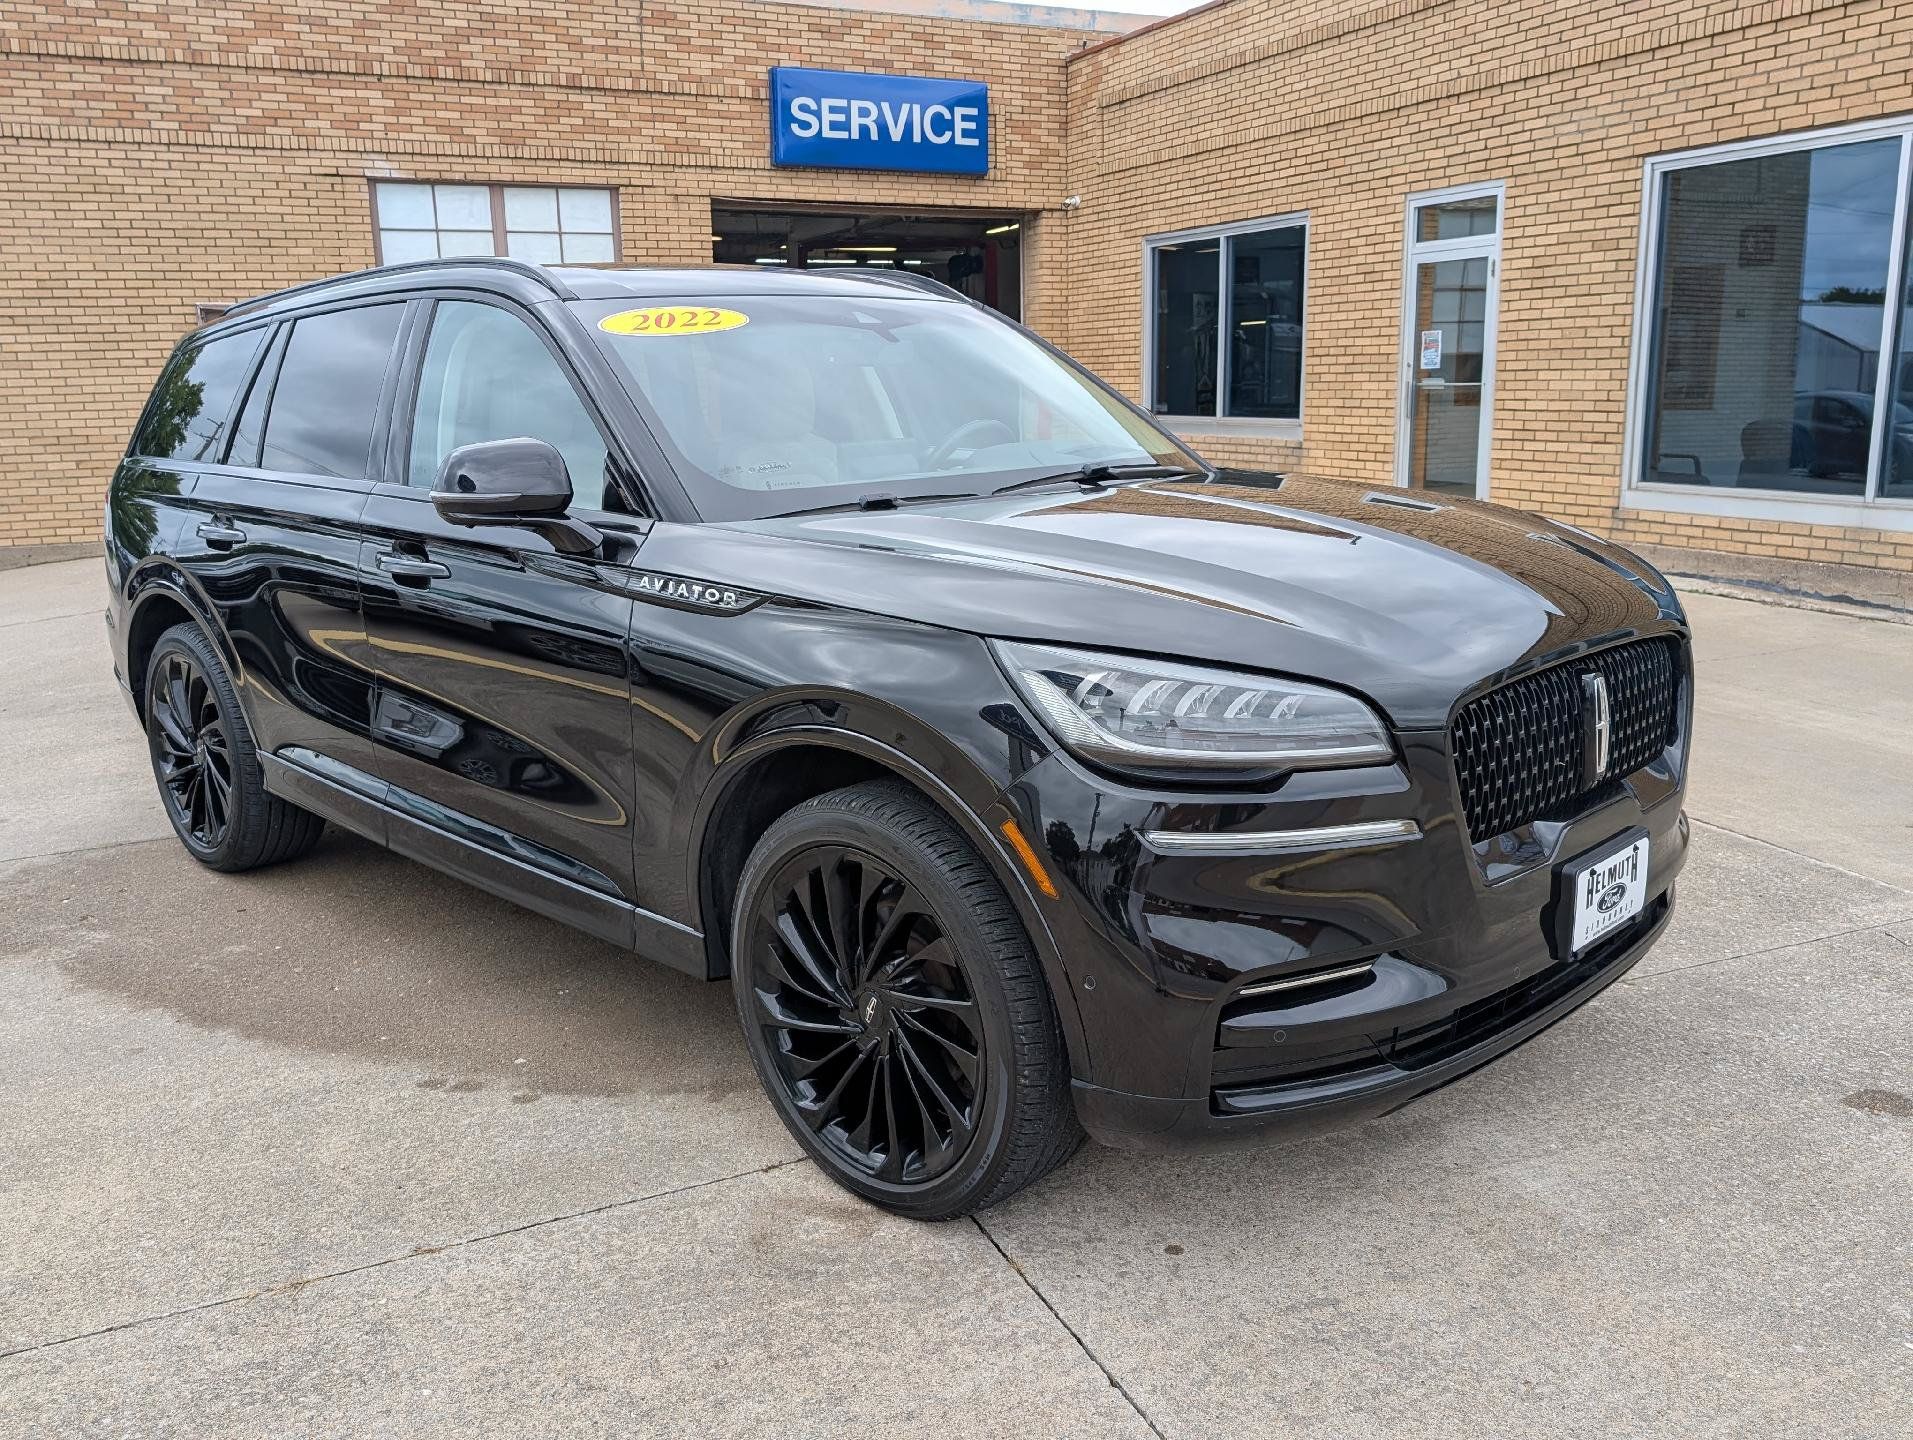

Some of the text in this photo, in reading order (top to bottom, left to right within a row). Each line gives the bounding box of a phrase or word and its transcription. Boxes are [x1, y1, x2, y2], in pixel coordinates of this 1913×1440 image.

[790, 97, 980, 147] SERVICE
[630, 310, 722, 331] 2022
[639, 576, 738, 608] AVIATOR
[1585, 852, 1639, 910] HELMUTH
